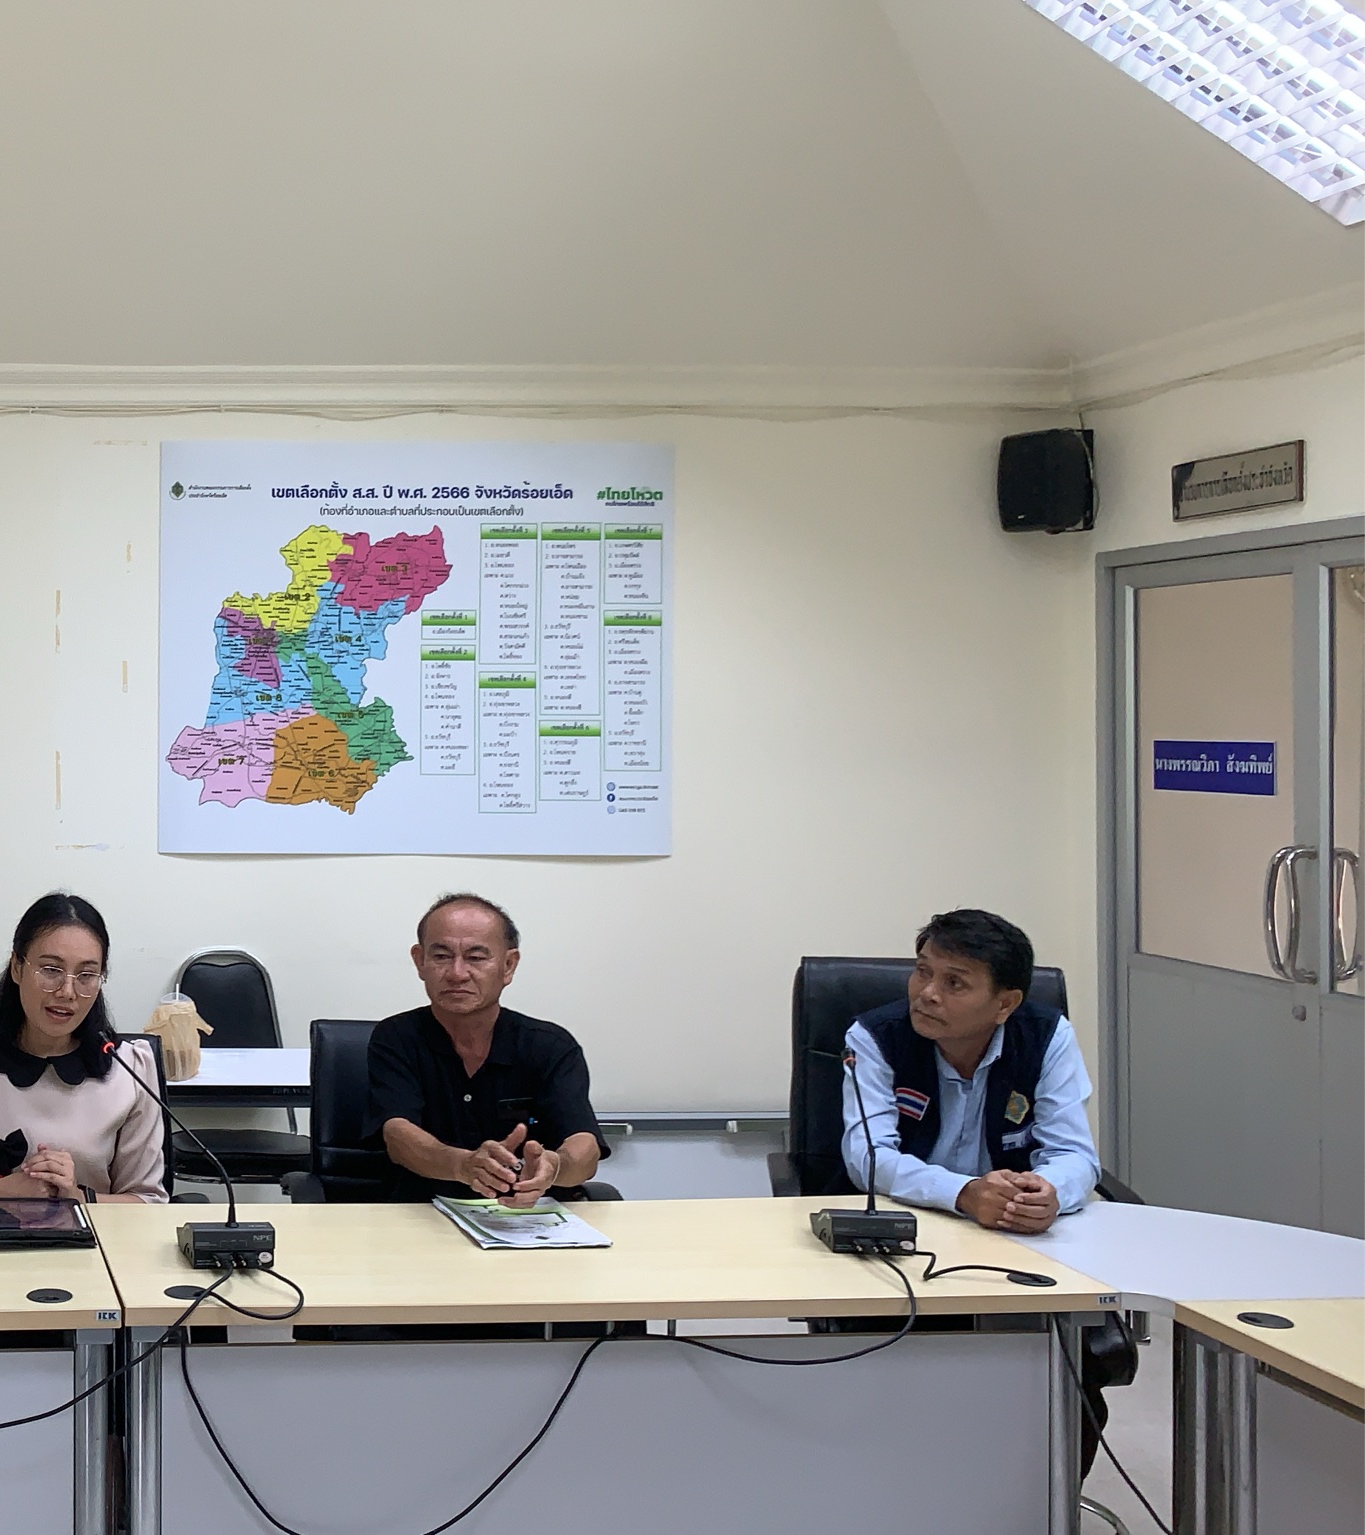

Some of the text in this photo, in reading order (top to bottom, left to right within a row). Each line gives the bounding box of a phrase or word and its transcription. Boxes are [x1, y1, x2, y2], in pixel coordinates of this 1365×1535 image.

[271, 480, 574, 499] เขตเลือกตั้ง ส.ส. ปี พ.ศ. 2566 จังหวัดร้อยเอ็ด
